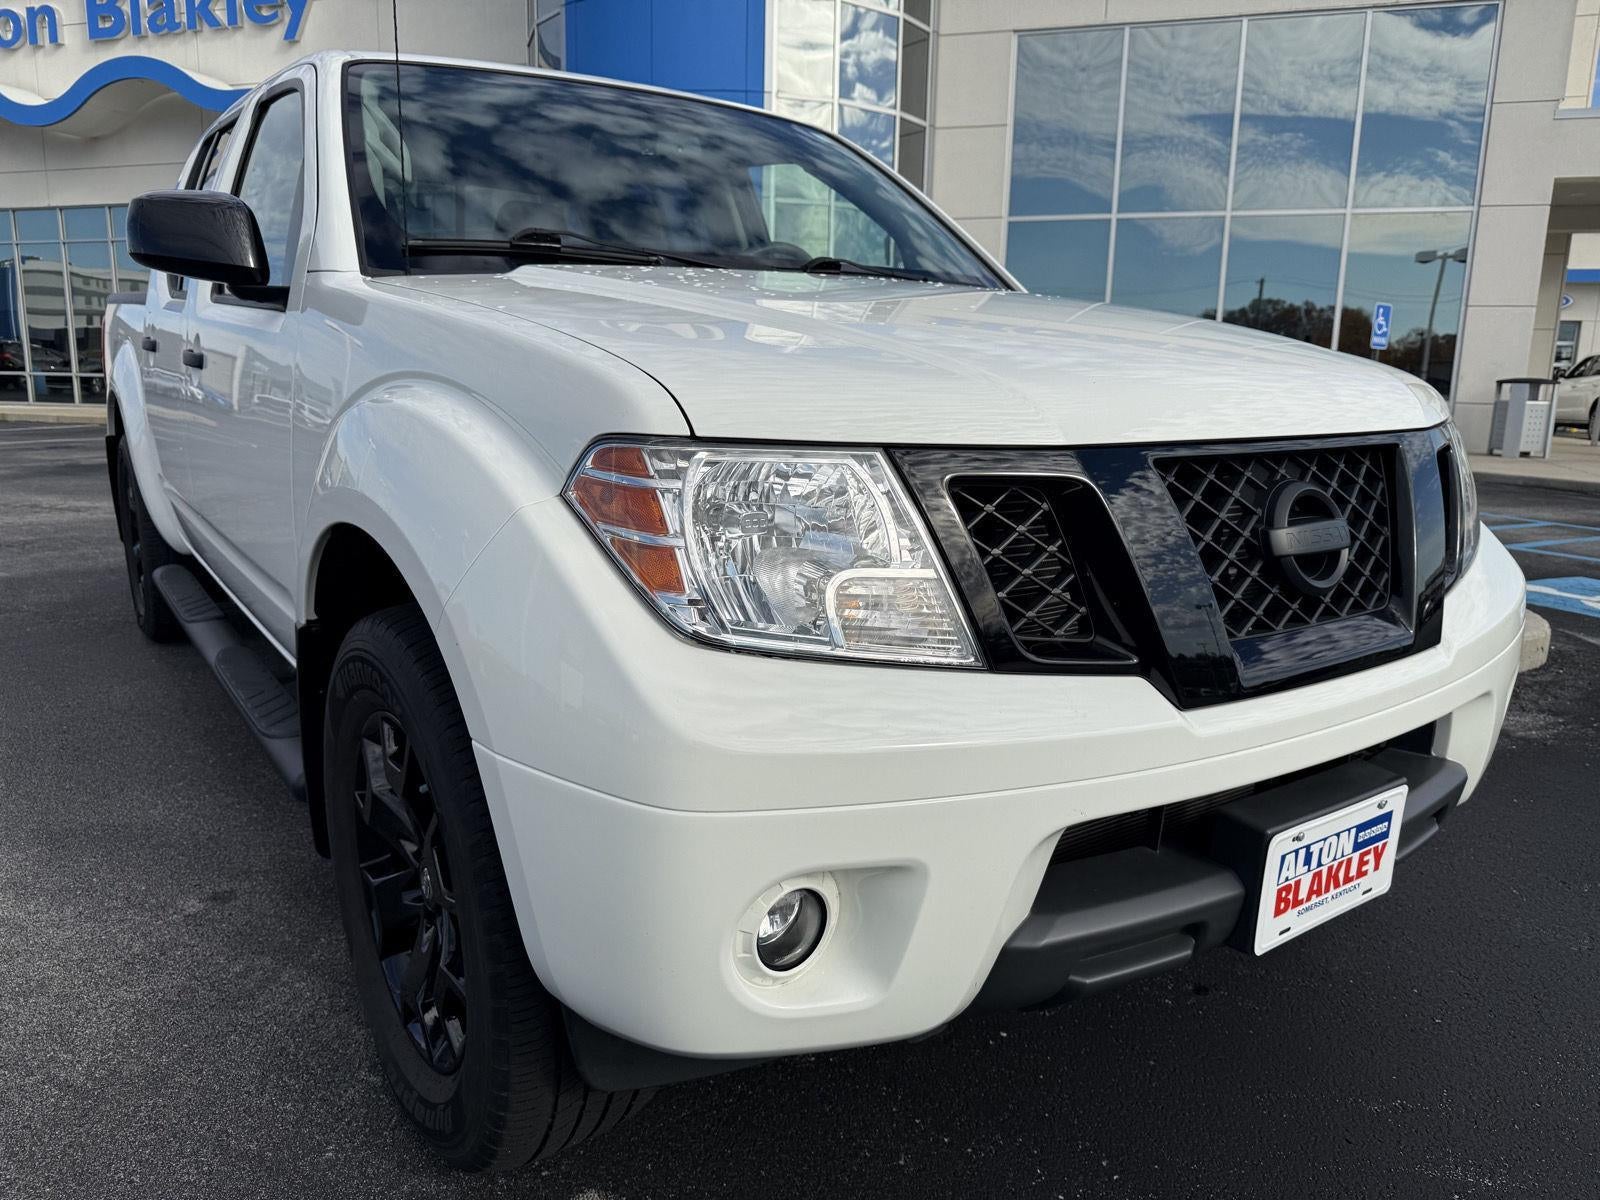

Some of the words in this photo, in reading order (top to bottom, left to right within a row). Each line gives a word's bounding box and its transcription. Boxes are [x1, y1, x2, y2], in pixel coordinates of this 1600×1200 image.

[1274, 842, 1388, 918] BLAKLEY
[1279, 829, 1356, 885] ALTON
[1297, 897, 1330, 917] SOMERSET,
[1331, 883, 1361, 901] KENTUCKY
